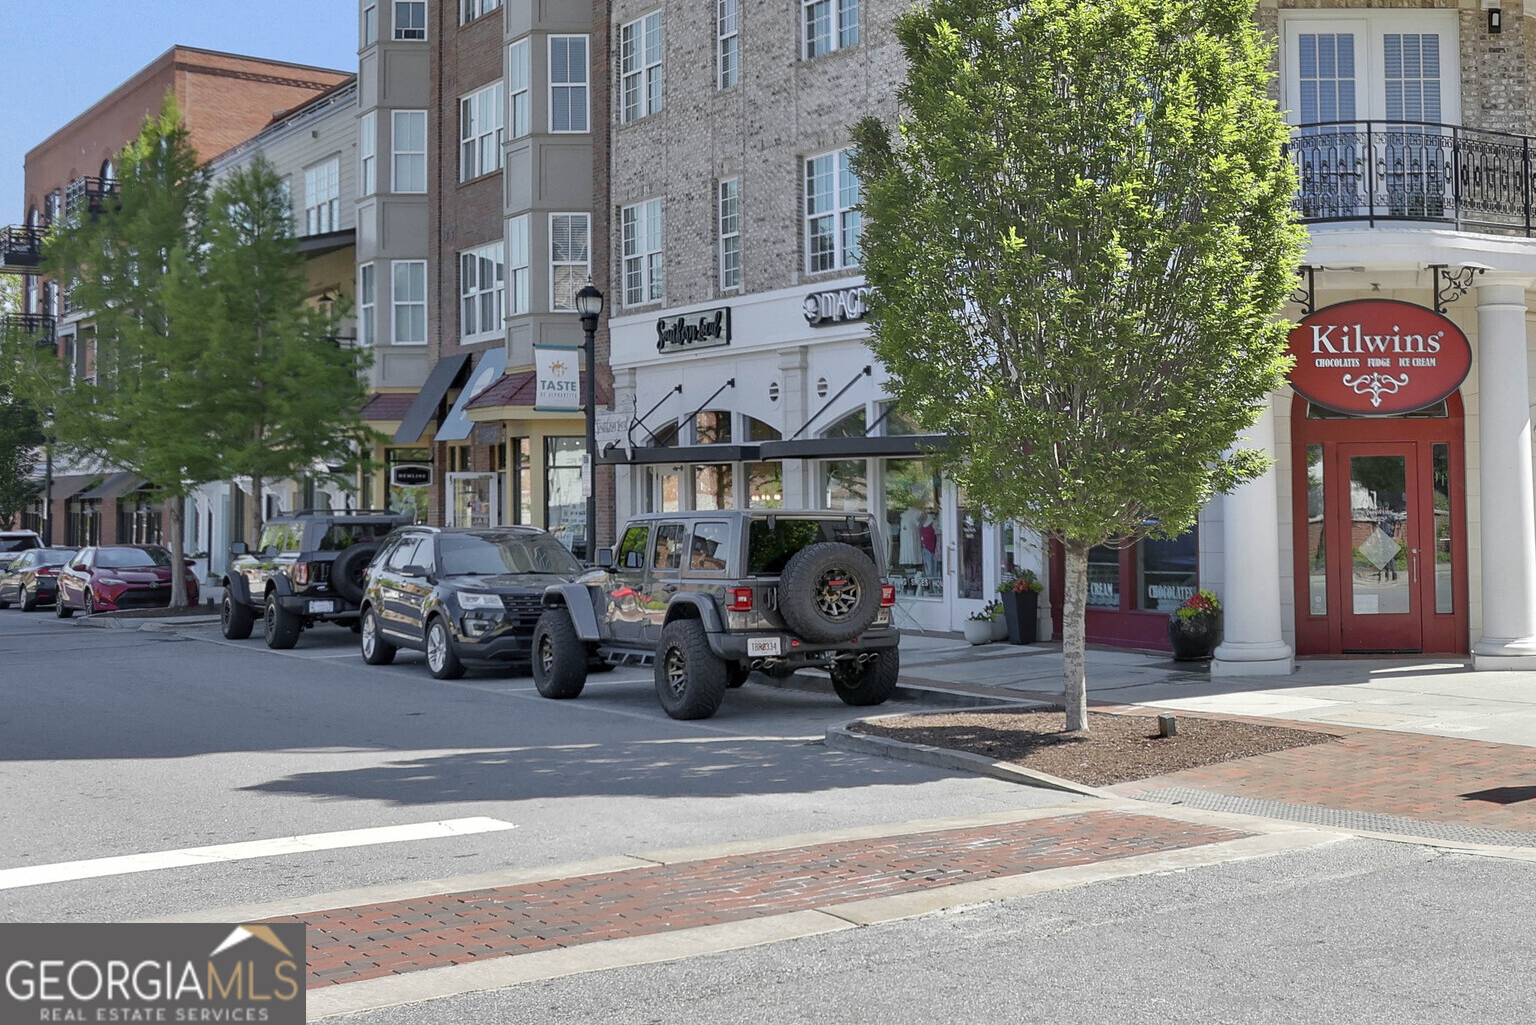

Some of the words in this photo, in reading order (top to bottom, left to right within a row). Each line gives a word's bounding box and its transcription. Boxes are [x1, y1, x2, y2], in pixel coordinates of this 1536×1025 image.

[1315, 357, 1360, 368] CHOCOLATES
[1367, 357, 1392, 368] FUDGE
[1398, 357, 1411, 367] ICE
[1412, 357, 1436, 367] CREAM
[540, 379, 577, 392] TASTE
